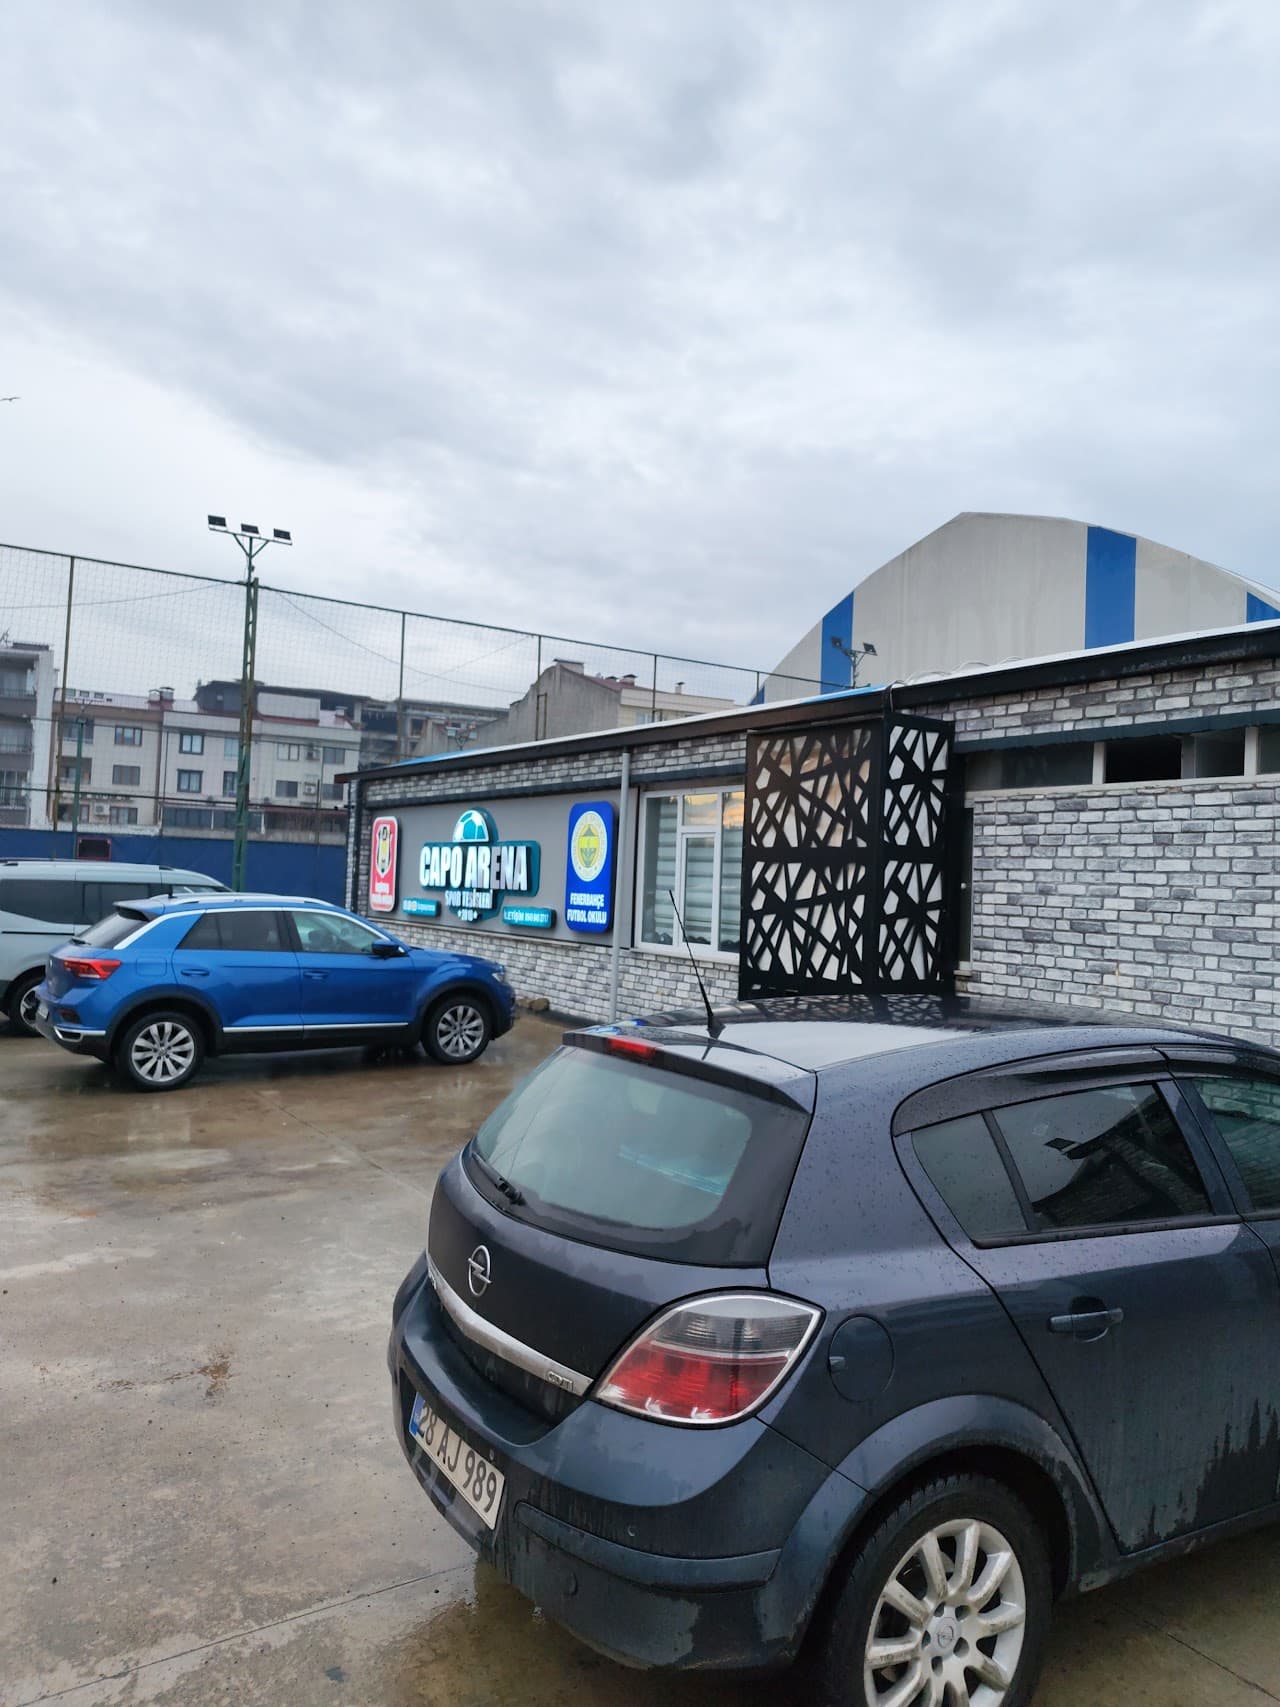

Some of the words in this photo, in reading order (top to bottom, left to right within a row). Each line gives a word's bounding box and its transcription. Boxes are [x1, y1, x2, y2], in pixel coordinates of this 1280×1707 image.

[420, 846, 463, 889] CAPO
[464, 846, 528, 891] ARENA
[567, 908, 587, 923] FUTBOL
[587, 910, 607, 924] OKULU
[570, 892, 605, 910] FENERBAHÇE
[418, 1404, 438, 1446] 28
[437, 1425, 463, 1473] AJ
[463, 1451, 498, 1514] 989
